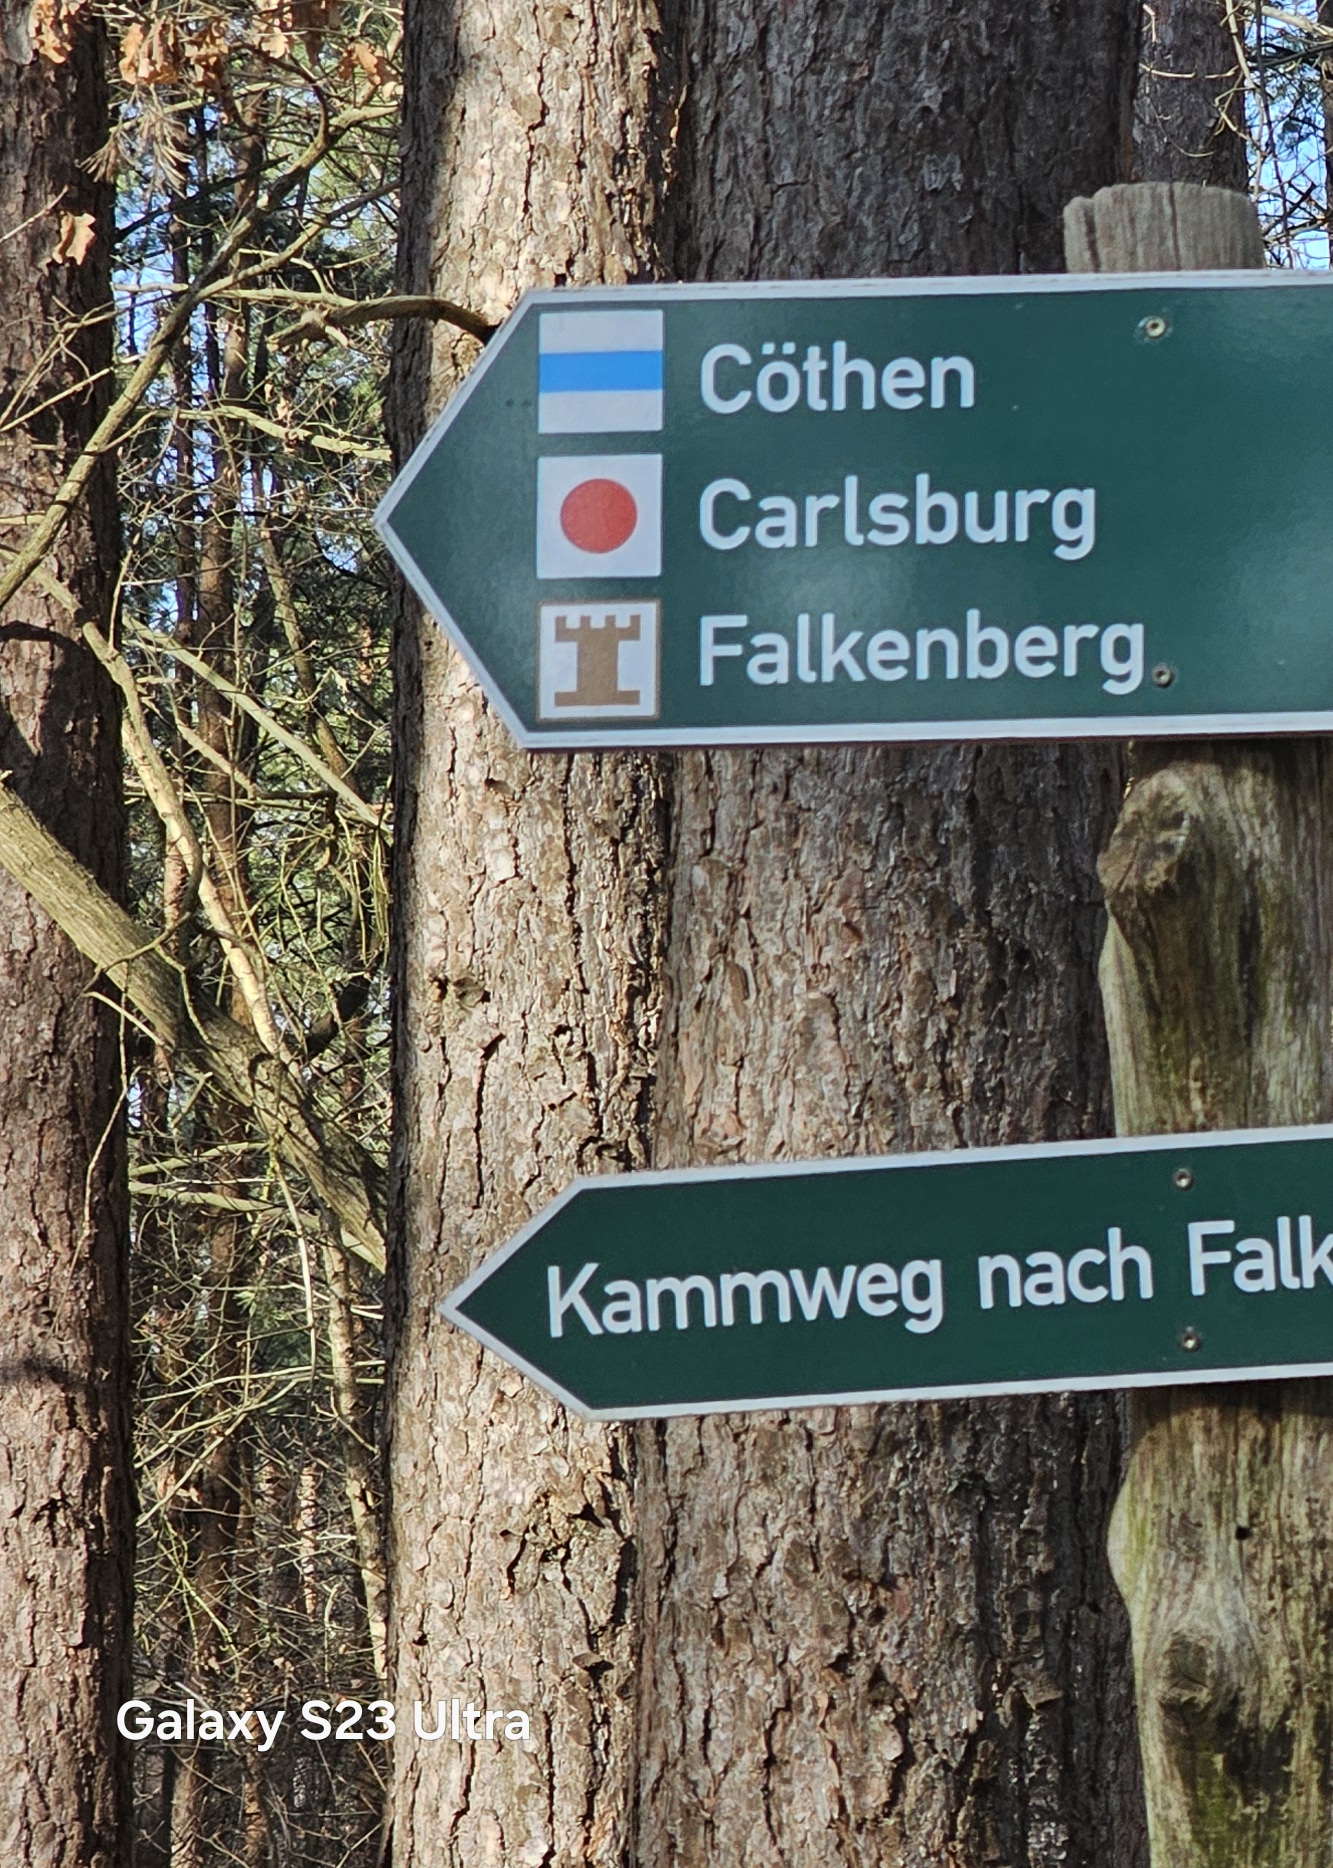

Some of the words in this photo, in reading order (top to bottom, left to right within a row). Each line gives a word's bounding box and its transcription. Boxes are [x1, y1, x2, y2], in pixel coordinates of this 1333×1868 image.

[700, 340, 975, 415] Cöthen
[699, 472, 1096, 561] Carlsburg
[700, 608, 1145, 696] Falkenberg
[546, 1258, 945, 1339] Kammweg
[977, 1226, 1155, 1310] nach
